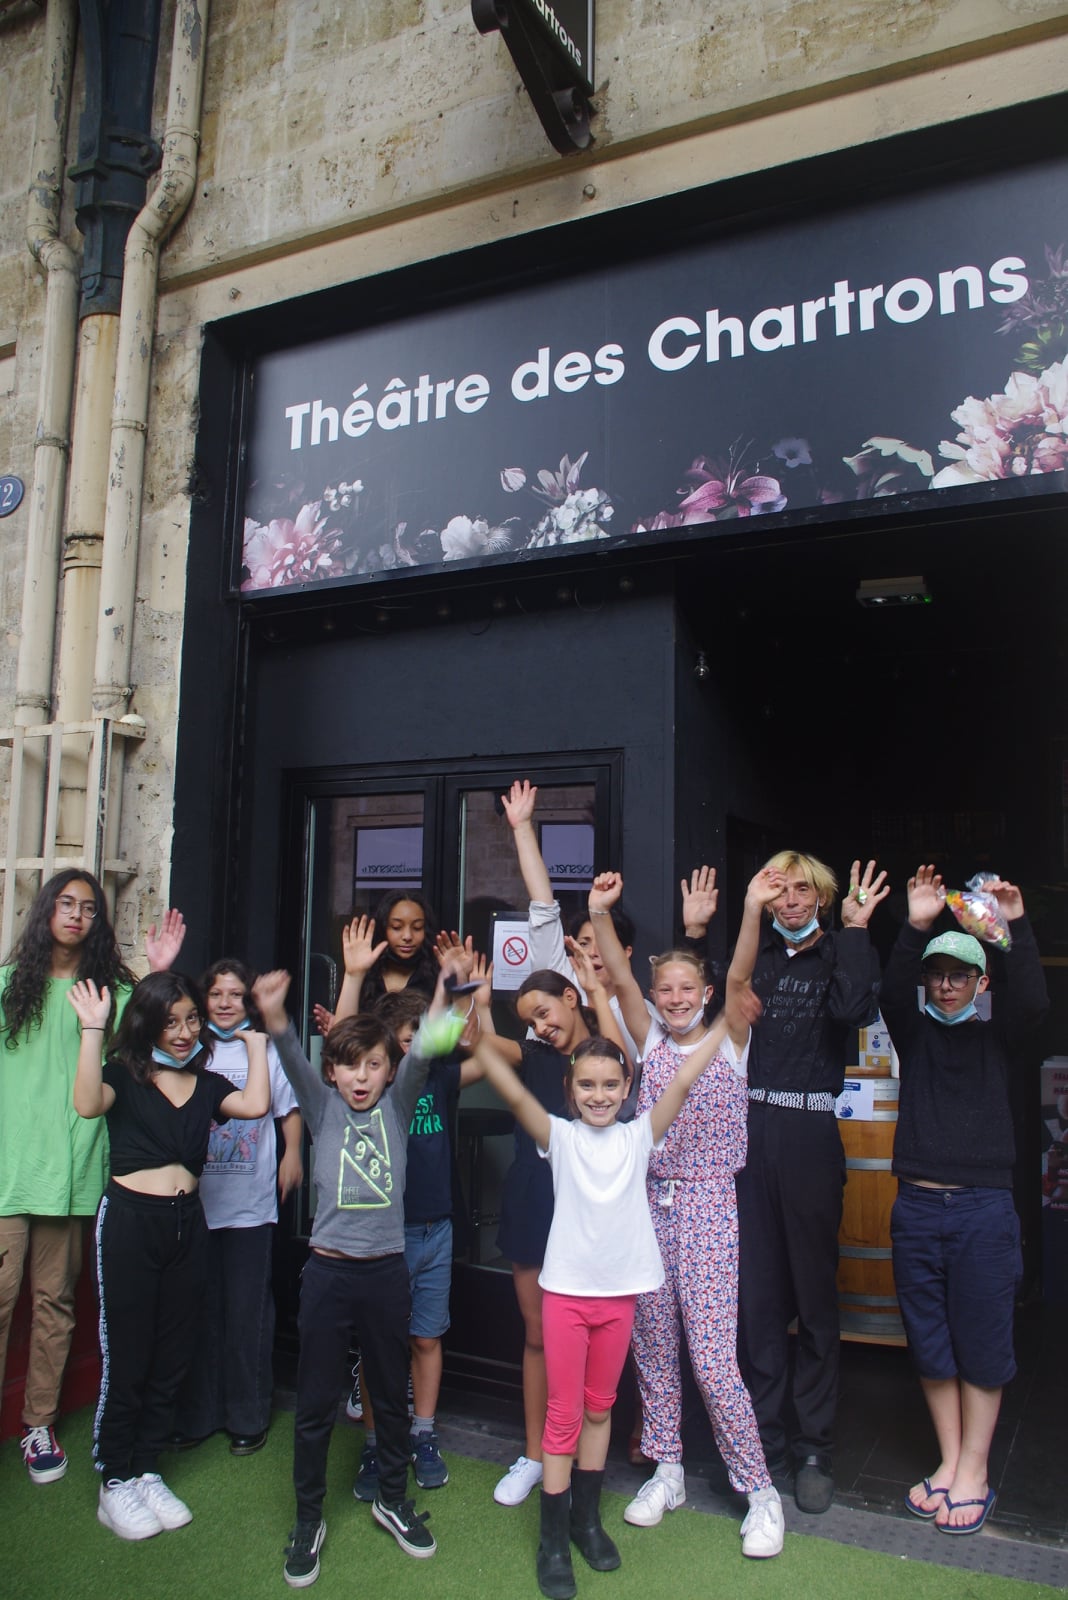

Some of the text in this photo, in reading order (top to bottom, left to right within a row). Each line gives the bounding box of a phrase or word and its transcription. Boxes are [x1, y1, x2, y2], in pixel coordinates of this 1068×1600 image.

[532, 0, 582, 66] artrons
[285, 256, 1029, 450] Théâtre des Chartrons
[0, 483, 14, 507] 2
